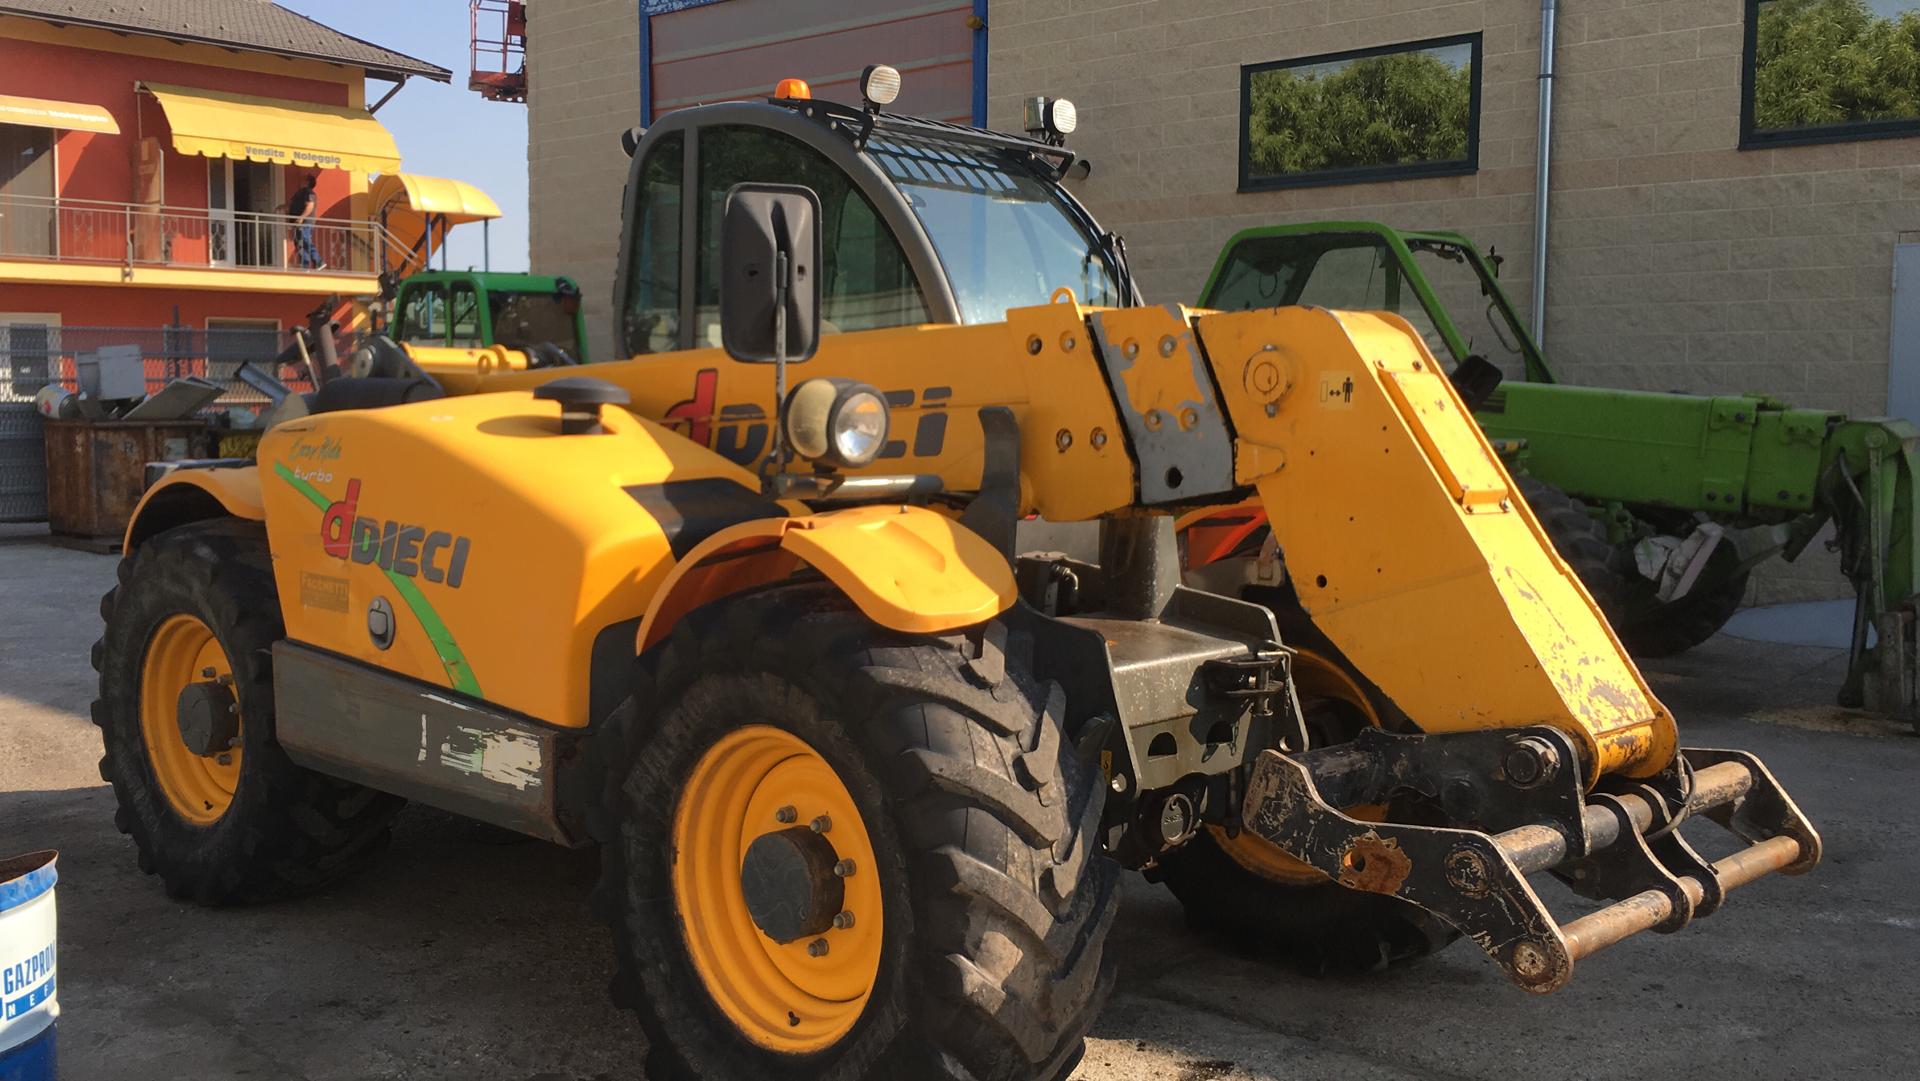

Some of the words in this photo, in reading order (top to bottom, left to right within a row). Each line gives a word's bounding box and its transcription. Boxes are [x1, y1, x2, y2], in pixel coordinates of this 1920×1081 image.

[245, 146, 285, 159] Vendita
[293, 151, 342, 164] Noleggio
[293, 466, 333, 483] turbo
